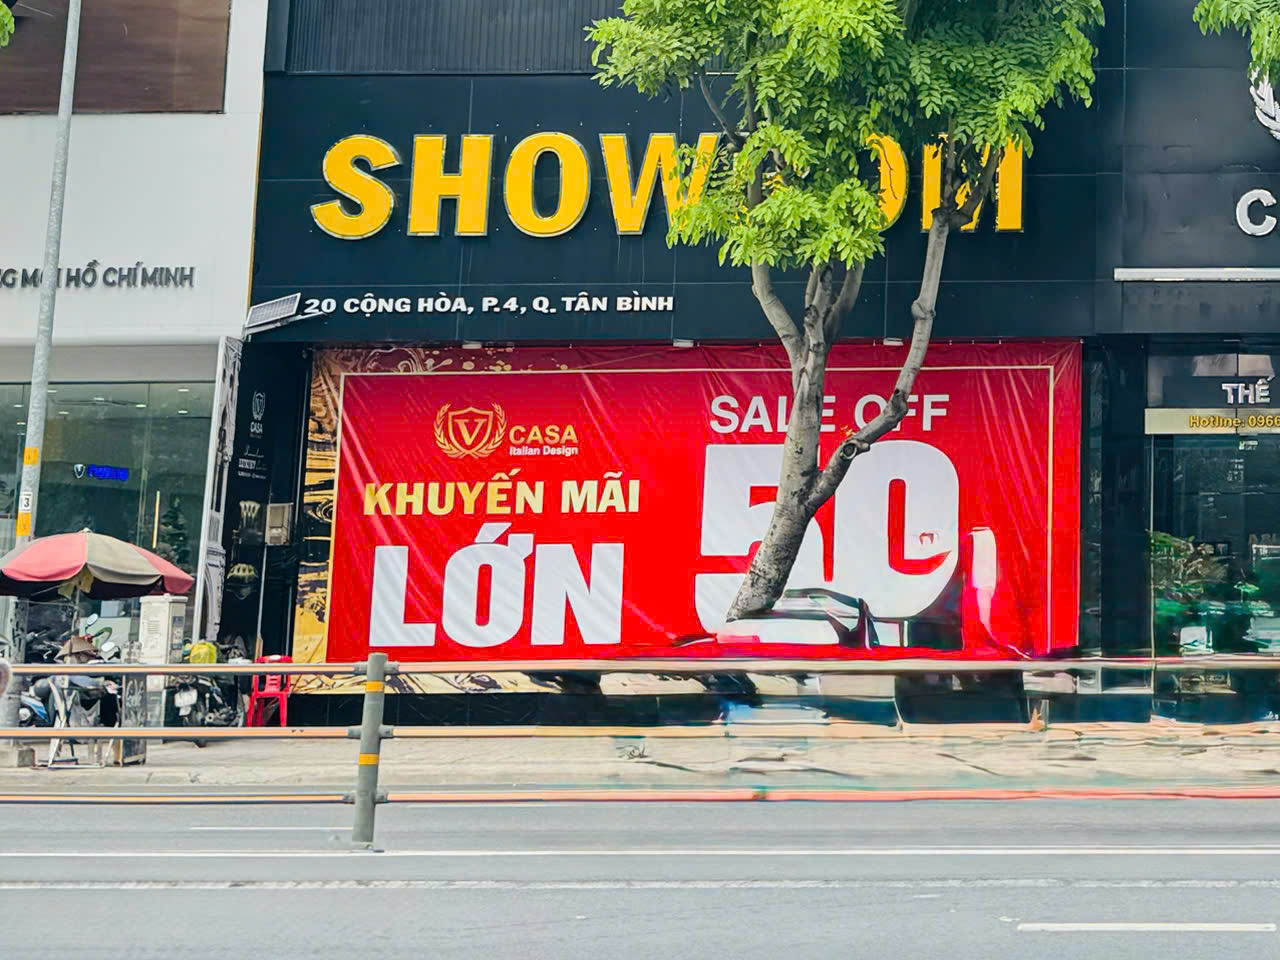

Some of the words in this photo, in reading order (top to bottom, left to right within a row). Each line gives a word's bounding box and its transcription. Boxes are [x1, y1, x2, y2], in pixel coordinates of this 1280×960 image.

[311, 132, 1026, 240] SHOWM
[65, 259, 100, 289] HỒ
[102, 260, 143, 288] CHÍ
[141, 266, 195, 288] MINH
[303, 297, 337, 314] 20
[343, 293, 411, 317] CỘNG
[416, 291, 474, 315] HÒA,
[531, 296, 557, 314] Q.
[561, 291, 608, 312] TÂN
[615, 290, 674, 312] BÌNH
[1221, 375, 1276, 405] THẾ
[508, 424, 578, 445] CASA
[1188, 415, 1246, 428] Hotline:
[509, 445, 541, 456] Italian
[542, 445, 579, 457] Design
[363, 468, 545, 516] KHUYẾN
[560, 471, 641, 514] MÃI
[695, 440, 960, 646] 50
[368, 521, 625, 648] LỚN
